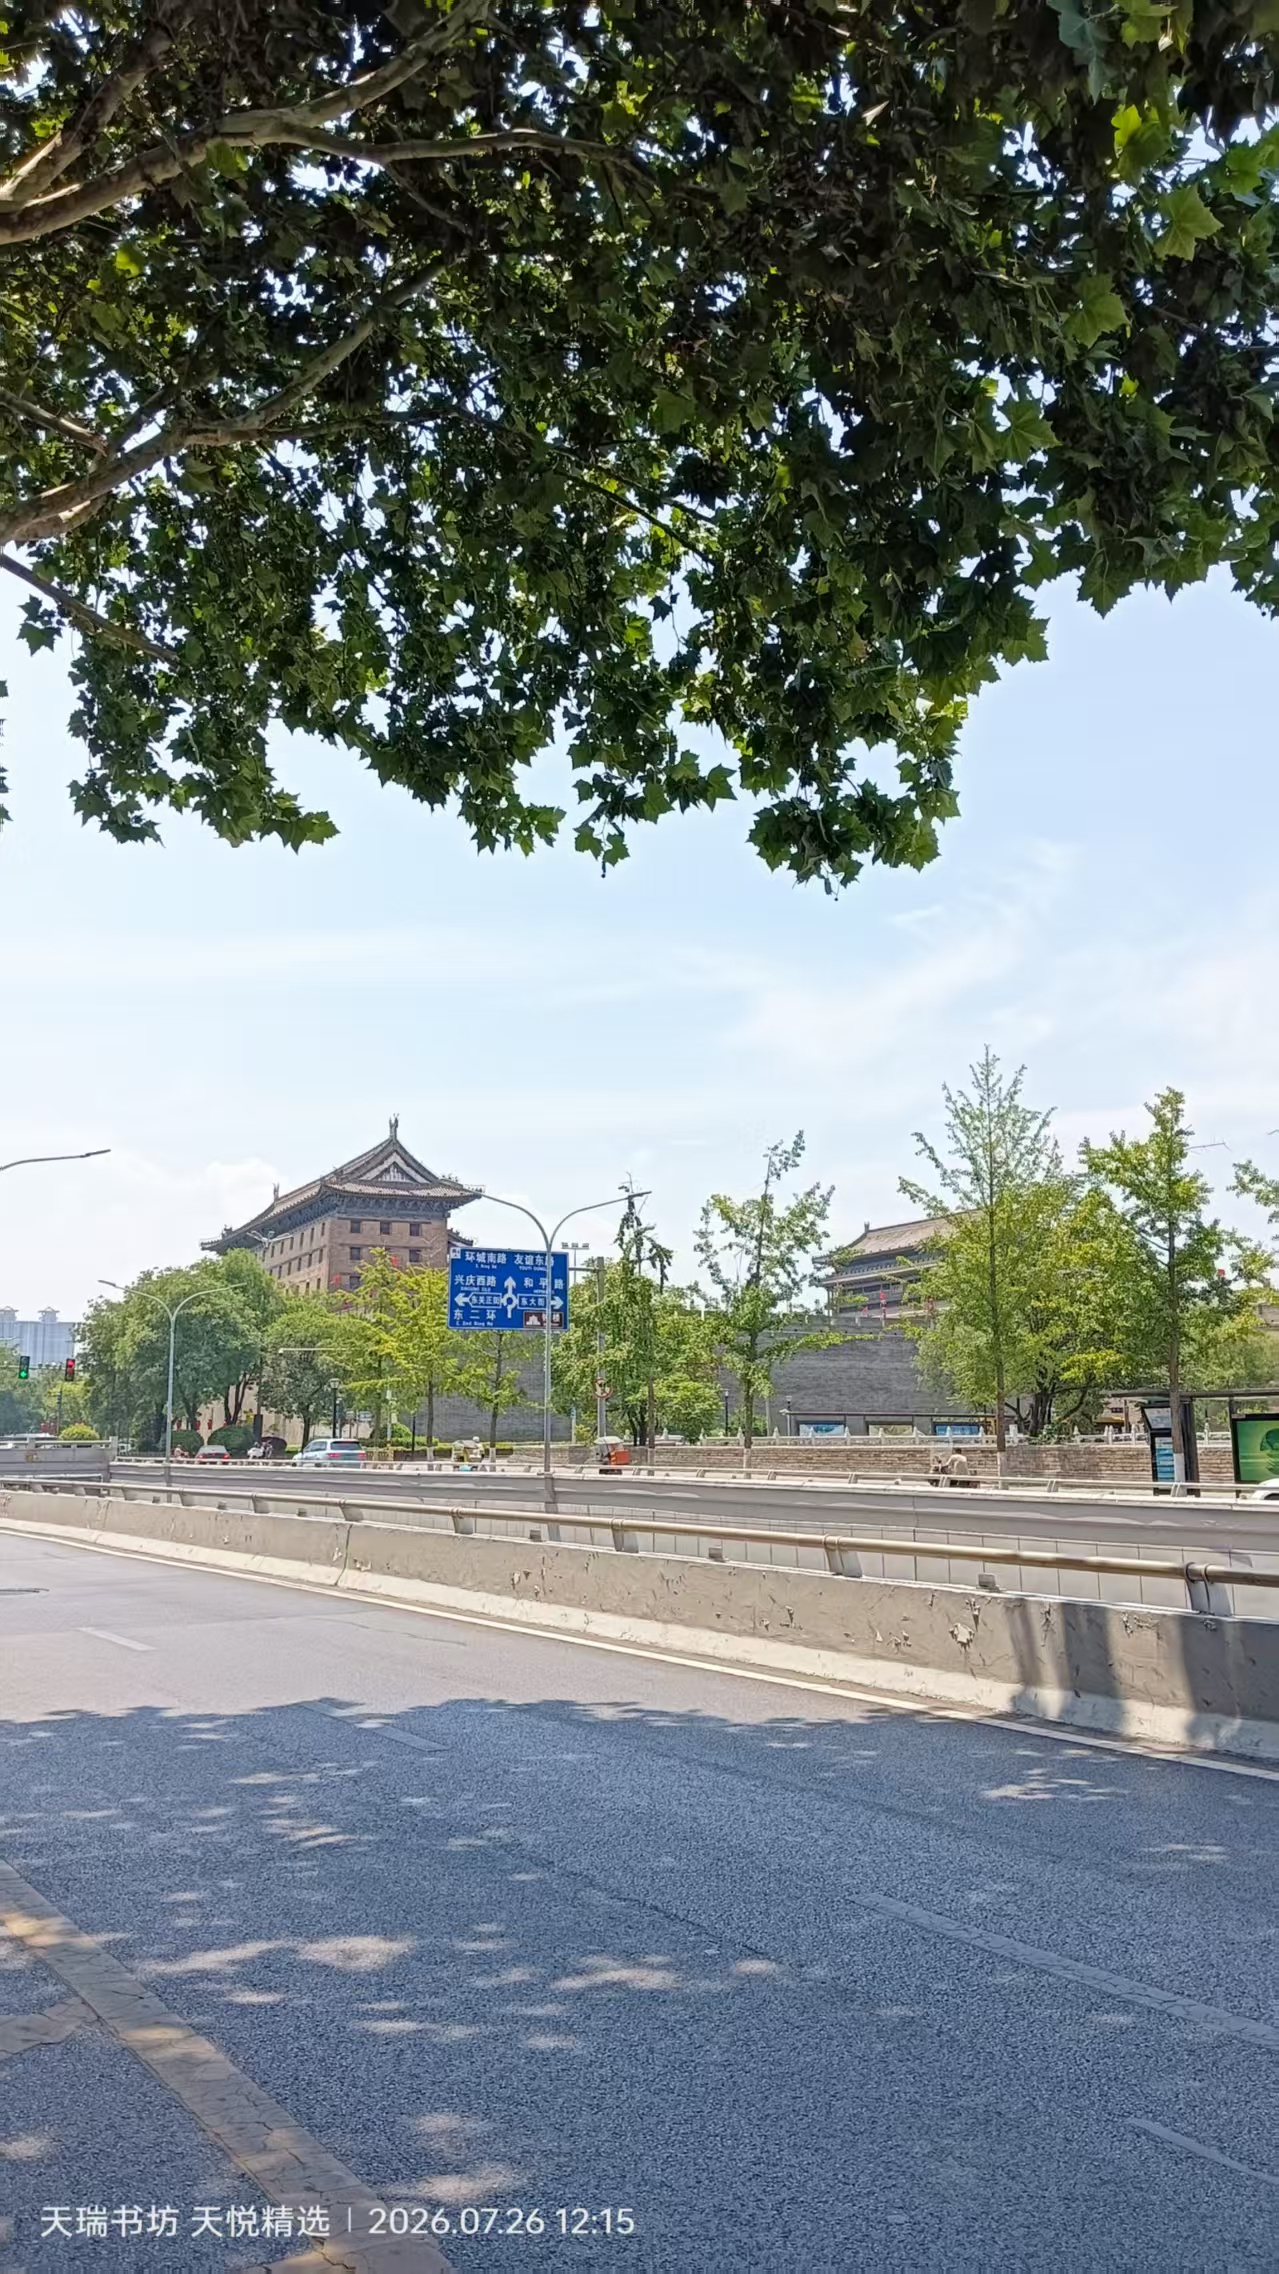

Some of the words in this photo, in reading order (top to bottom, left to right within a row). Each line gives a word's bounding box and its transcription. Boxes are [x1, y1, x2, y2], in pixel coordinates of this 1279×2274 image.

[465, 1251, 507, 1265] 环城南路
[454, 1274, 497, 1287] 兴庆西路
[453, 1308, 497, 1321] 东二环
